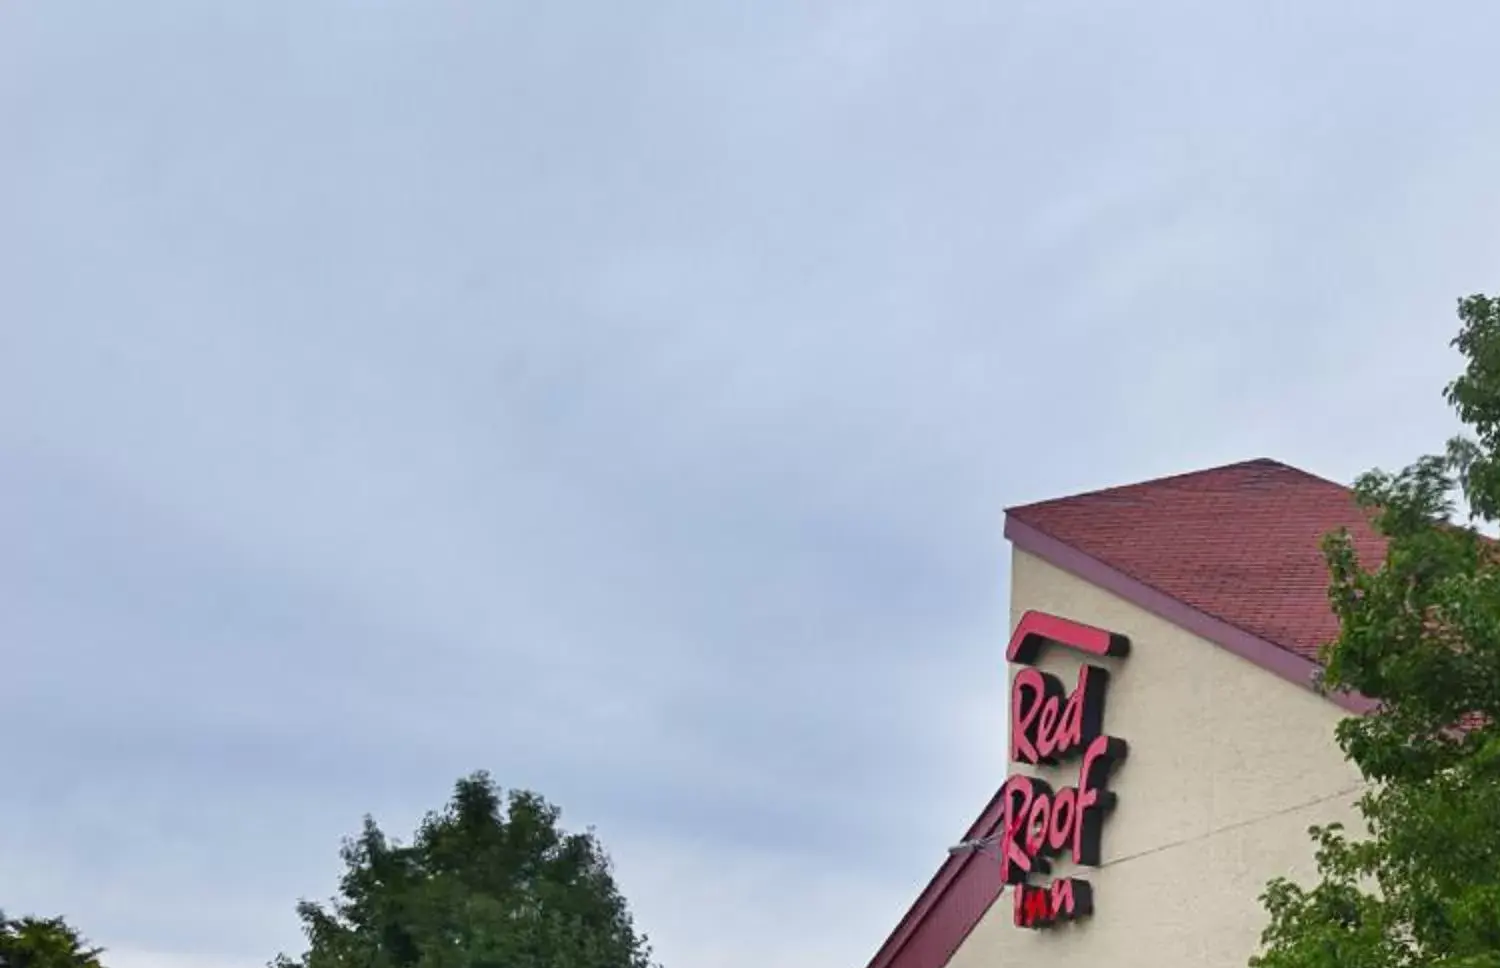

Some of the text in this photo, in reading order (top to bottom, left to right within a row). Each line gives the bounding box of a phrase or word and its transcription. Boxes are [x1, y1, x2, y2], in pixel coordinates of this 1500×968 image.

[1012, 664, 1089, 764] Red
[1001, 735, 1108, 883] Roof
[1014, 877, 1075, 928] Inn
